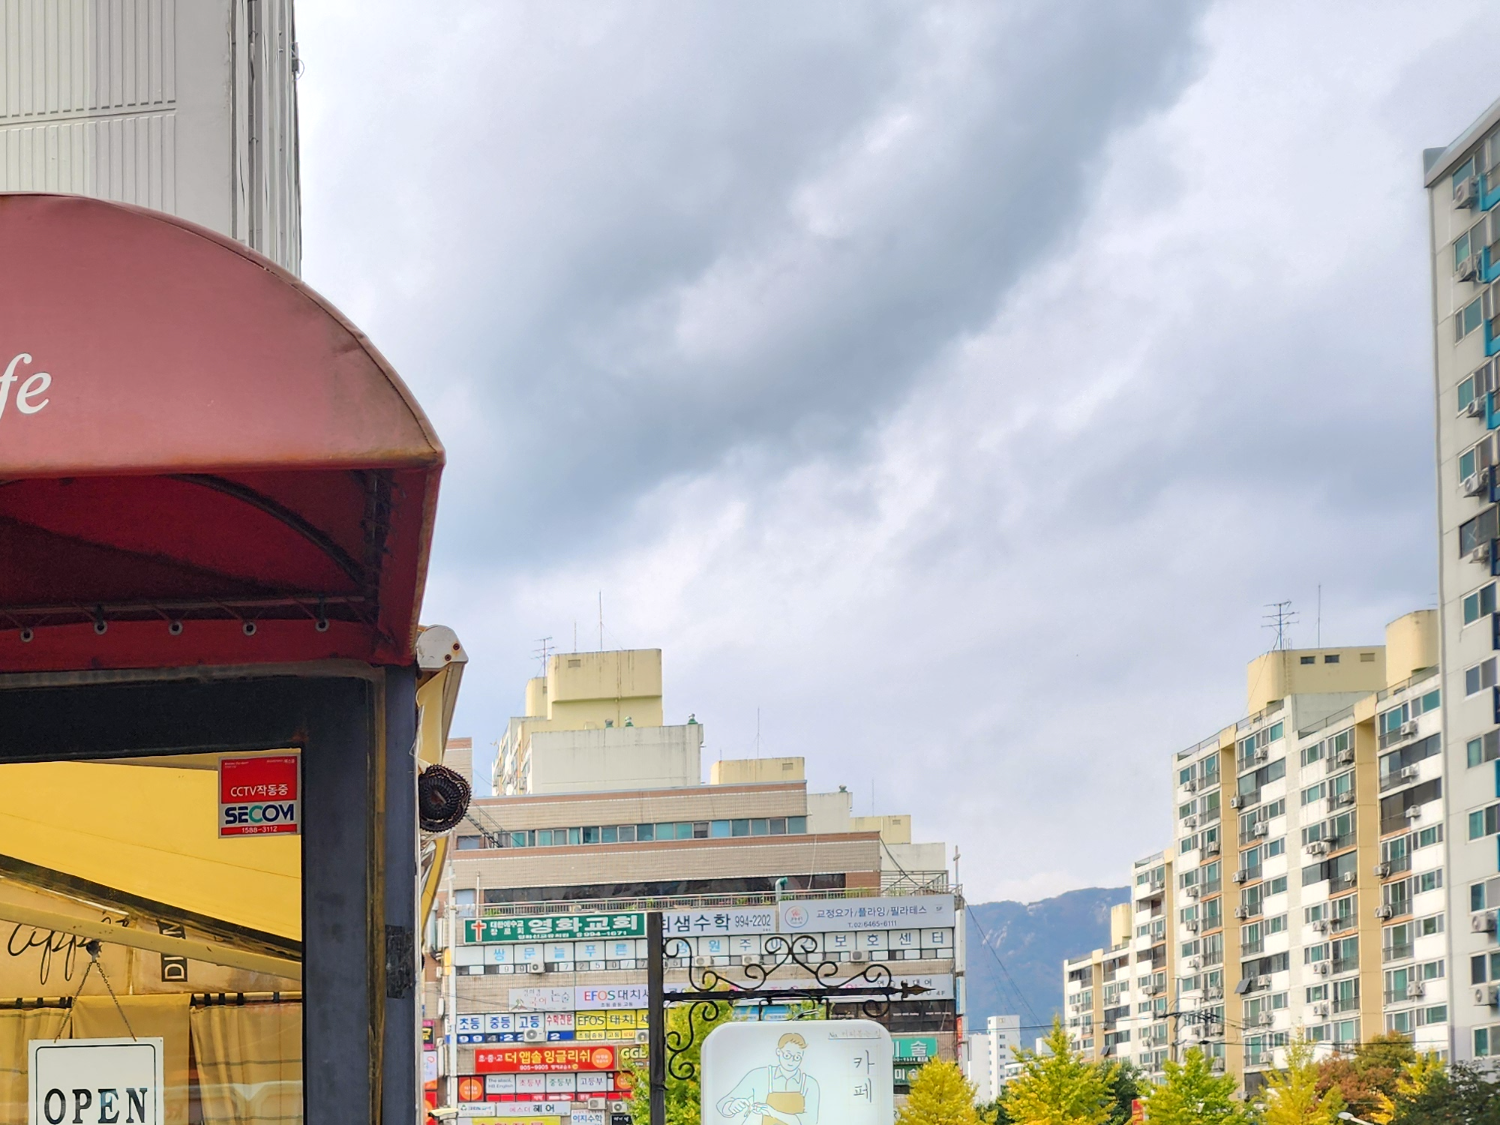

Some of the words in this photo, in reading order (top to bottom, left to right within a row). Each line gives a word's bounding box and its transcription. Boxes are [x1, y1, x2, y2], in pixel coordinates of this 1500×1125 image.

[230, 784, 288, 797] CCTV작동중
[225, 803, 294, 824] SECOM
[241, 825, 278, 834] 1588-3112
[528, 915, 637, 934] 영화교회
[735, 914, 771, 928] 994-2202
[584, 990, 616, 1002] EFOS
[459, 1017, 480, 1031] 초등
[490, 1016, 510, 1029] 중등
[519, 1015, 540, 1029] 고등
[546, 1014, 572, 1026] 수학전문
[577, 1016, 605, 1026] EFOS
[504, 1051, 517, 1064] 더
[519, 1050, 542, 1064] 앱솔
[544, 1049, 591, 1063] 잉글리쉬
[44, 1087, 148, 1125] OPEN
[533, 1104, 555, 1113] 헤어
